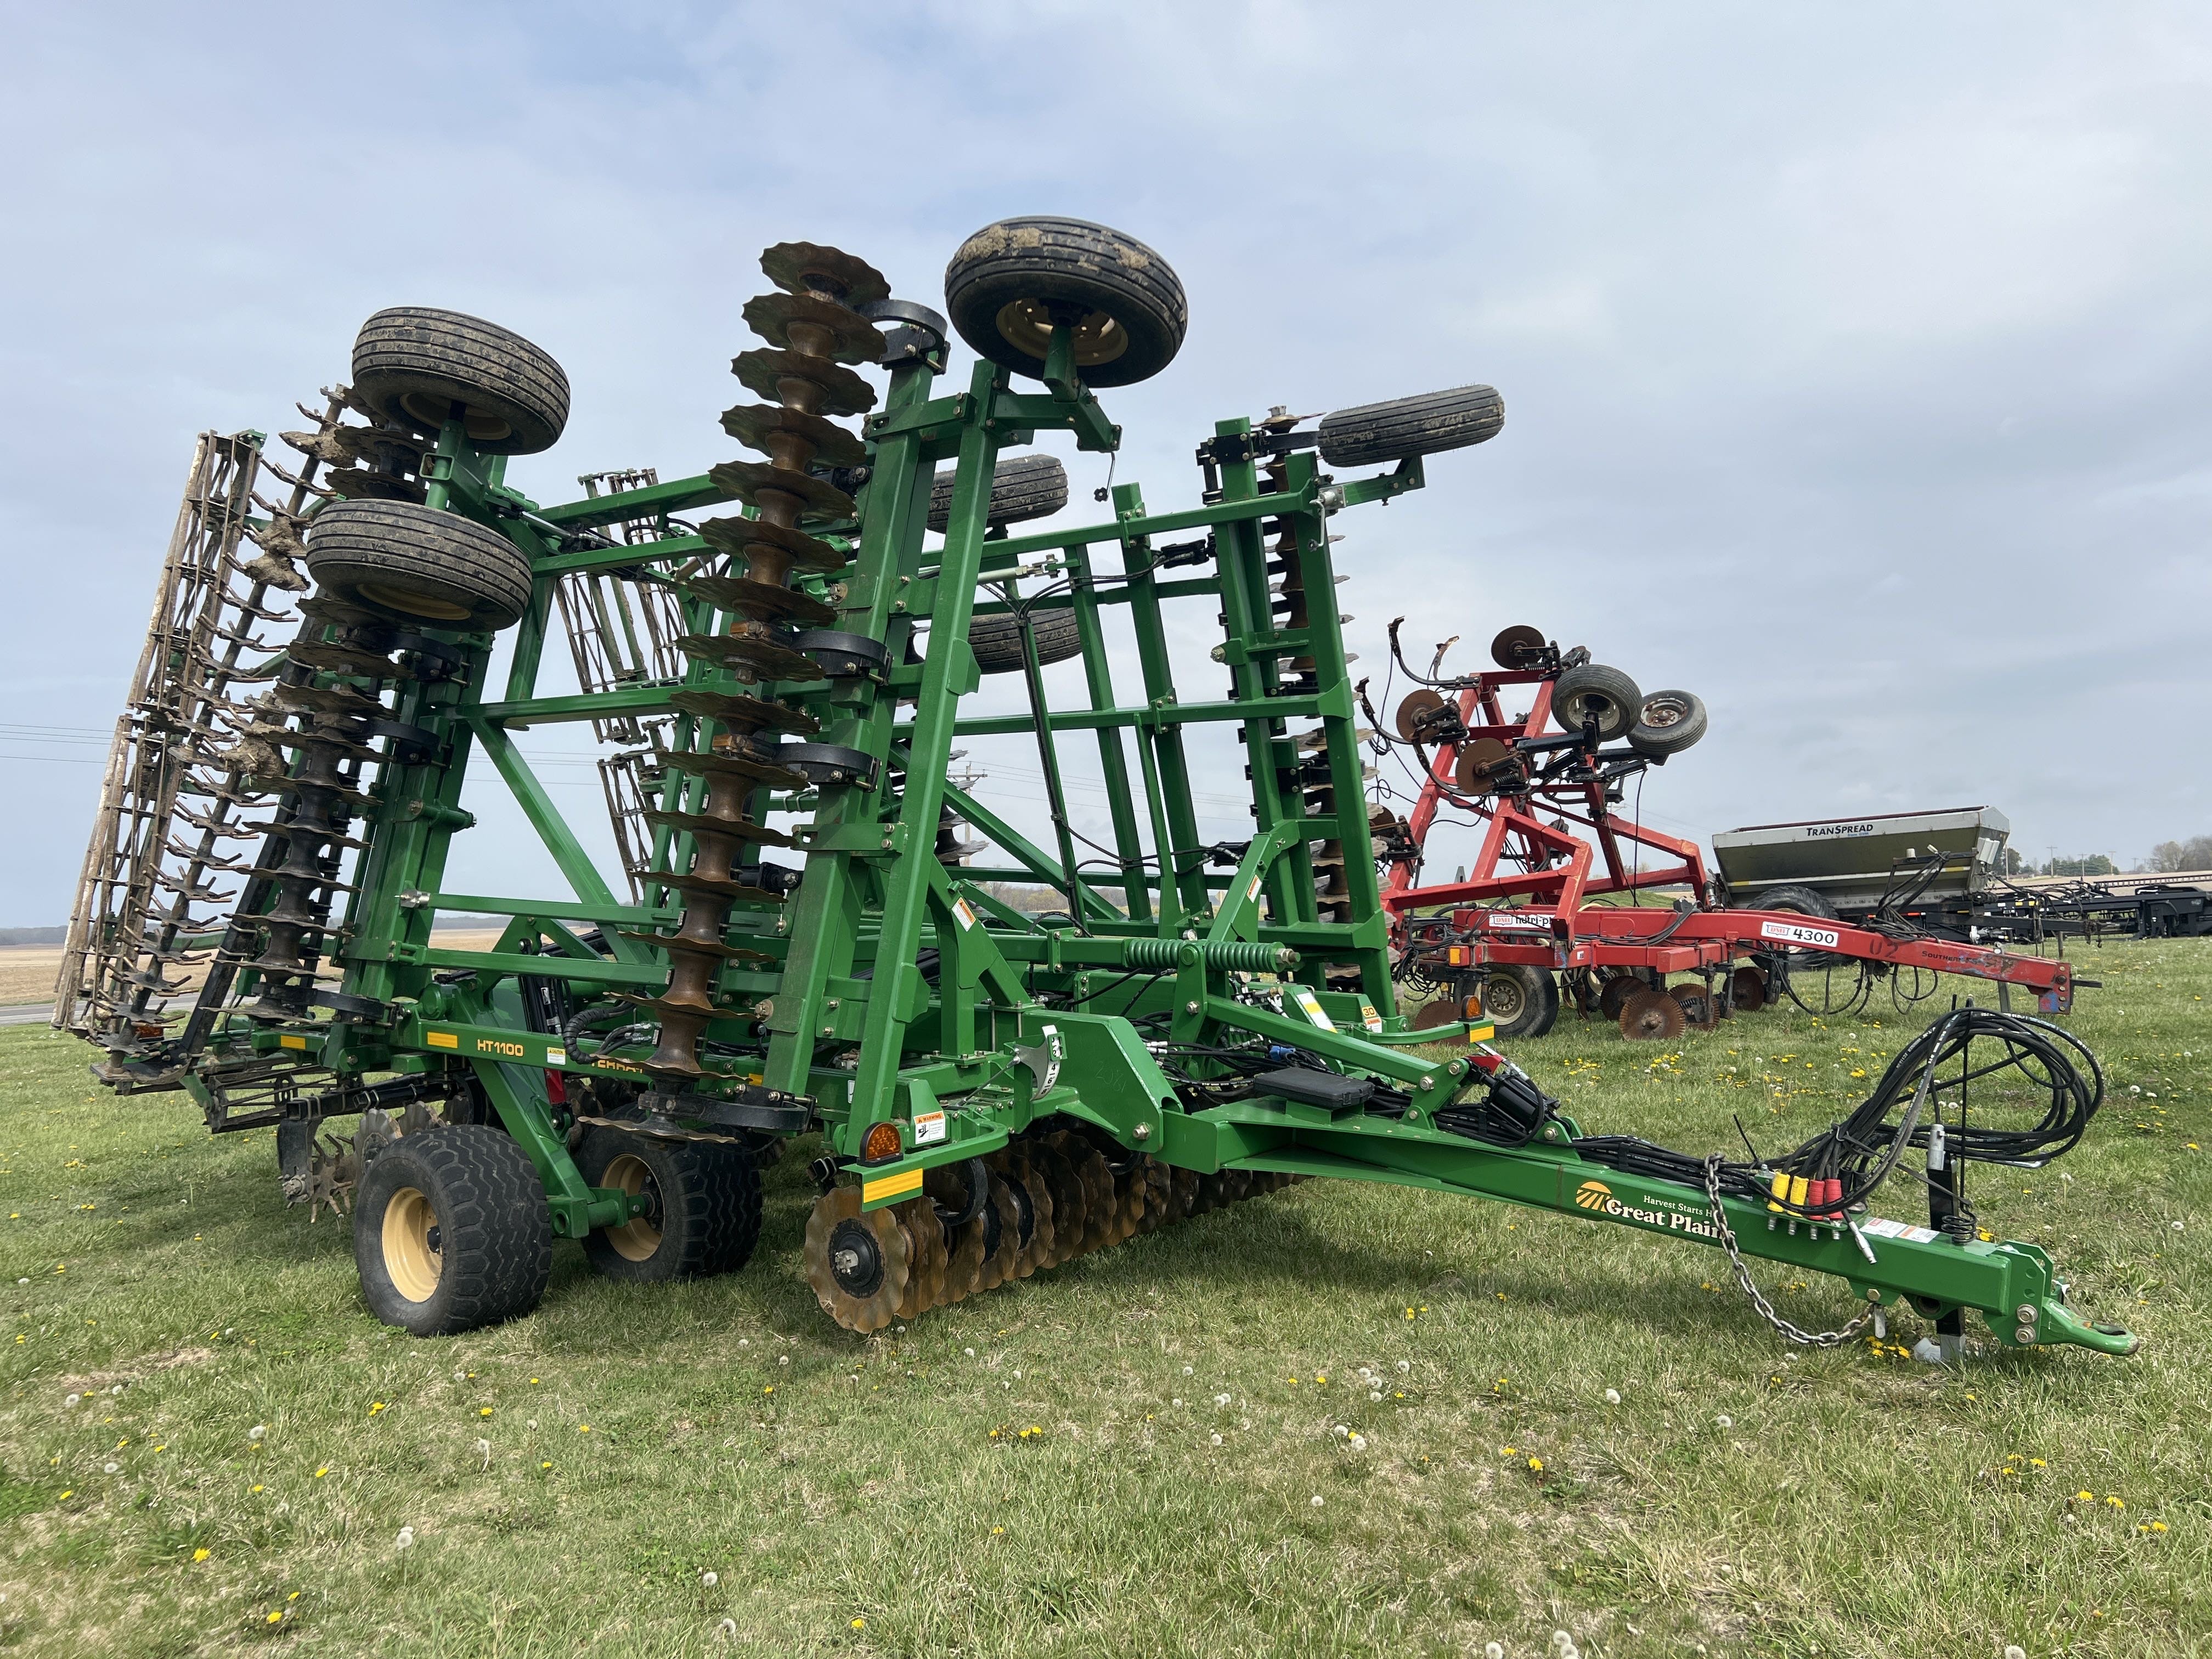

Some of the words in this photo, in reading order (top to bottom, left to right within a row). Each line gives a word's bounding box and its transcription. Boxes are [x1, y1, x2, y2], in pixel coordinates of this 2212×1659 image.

[1793, 928, 1835, 944] 4300
[1363, 1007, 1375, 1016] 30
[477, 1039, 524, 1057] HT1100
[1606, 1199, 1665, 1226] Great
[1644, 1195, 1676, 1209] Harvest
[1678, 1203, 1703, 1215] Starts
